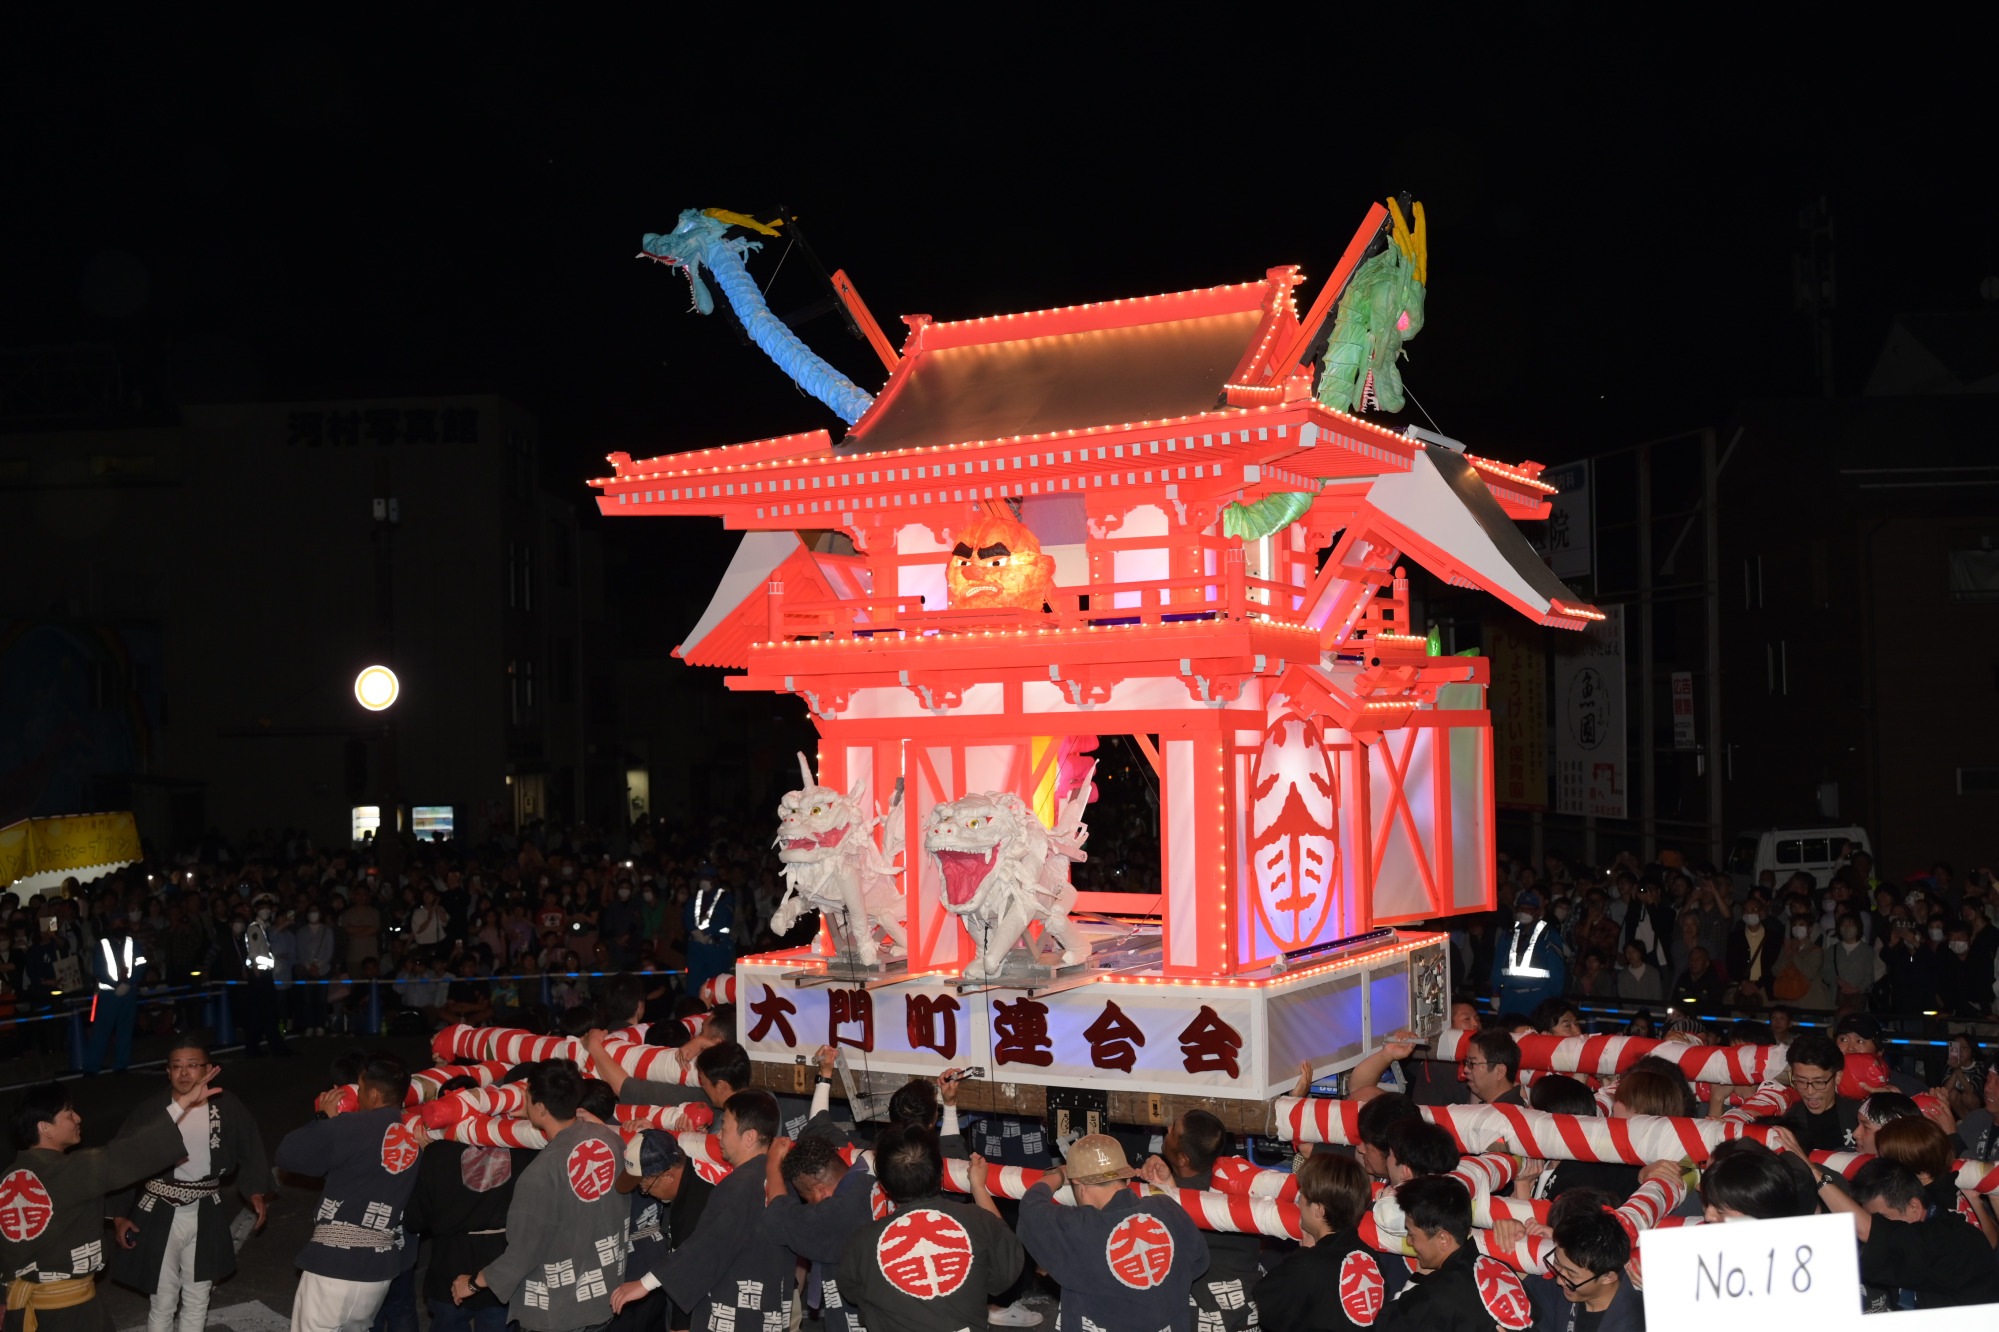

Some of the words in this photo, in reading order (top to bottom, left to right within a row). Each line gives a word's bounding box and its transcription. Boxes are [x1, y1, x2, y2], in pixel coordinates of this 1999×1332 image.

[287, 407, 479, 446] 河村写真館
[748, 982, 1243, 1080] 大門町連合会
[209, 1104, 221, 1150] 大門会
[1094, 1148, 1112, 1166] LA
[1696, 1244, 1812, 1302] No.18
